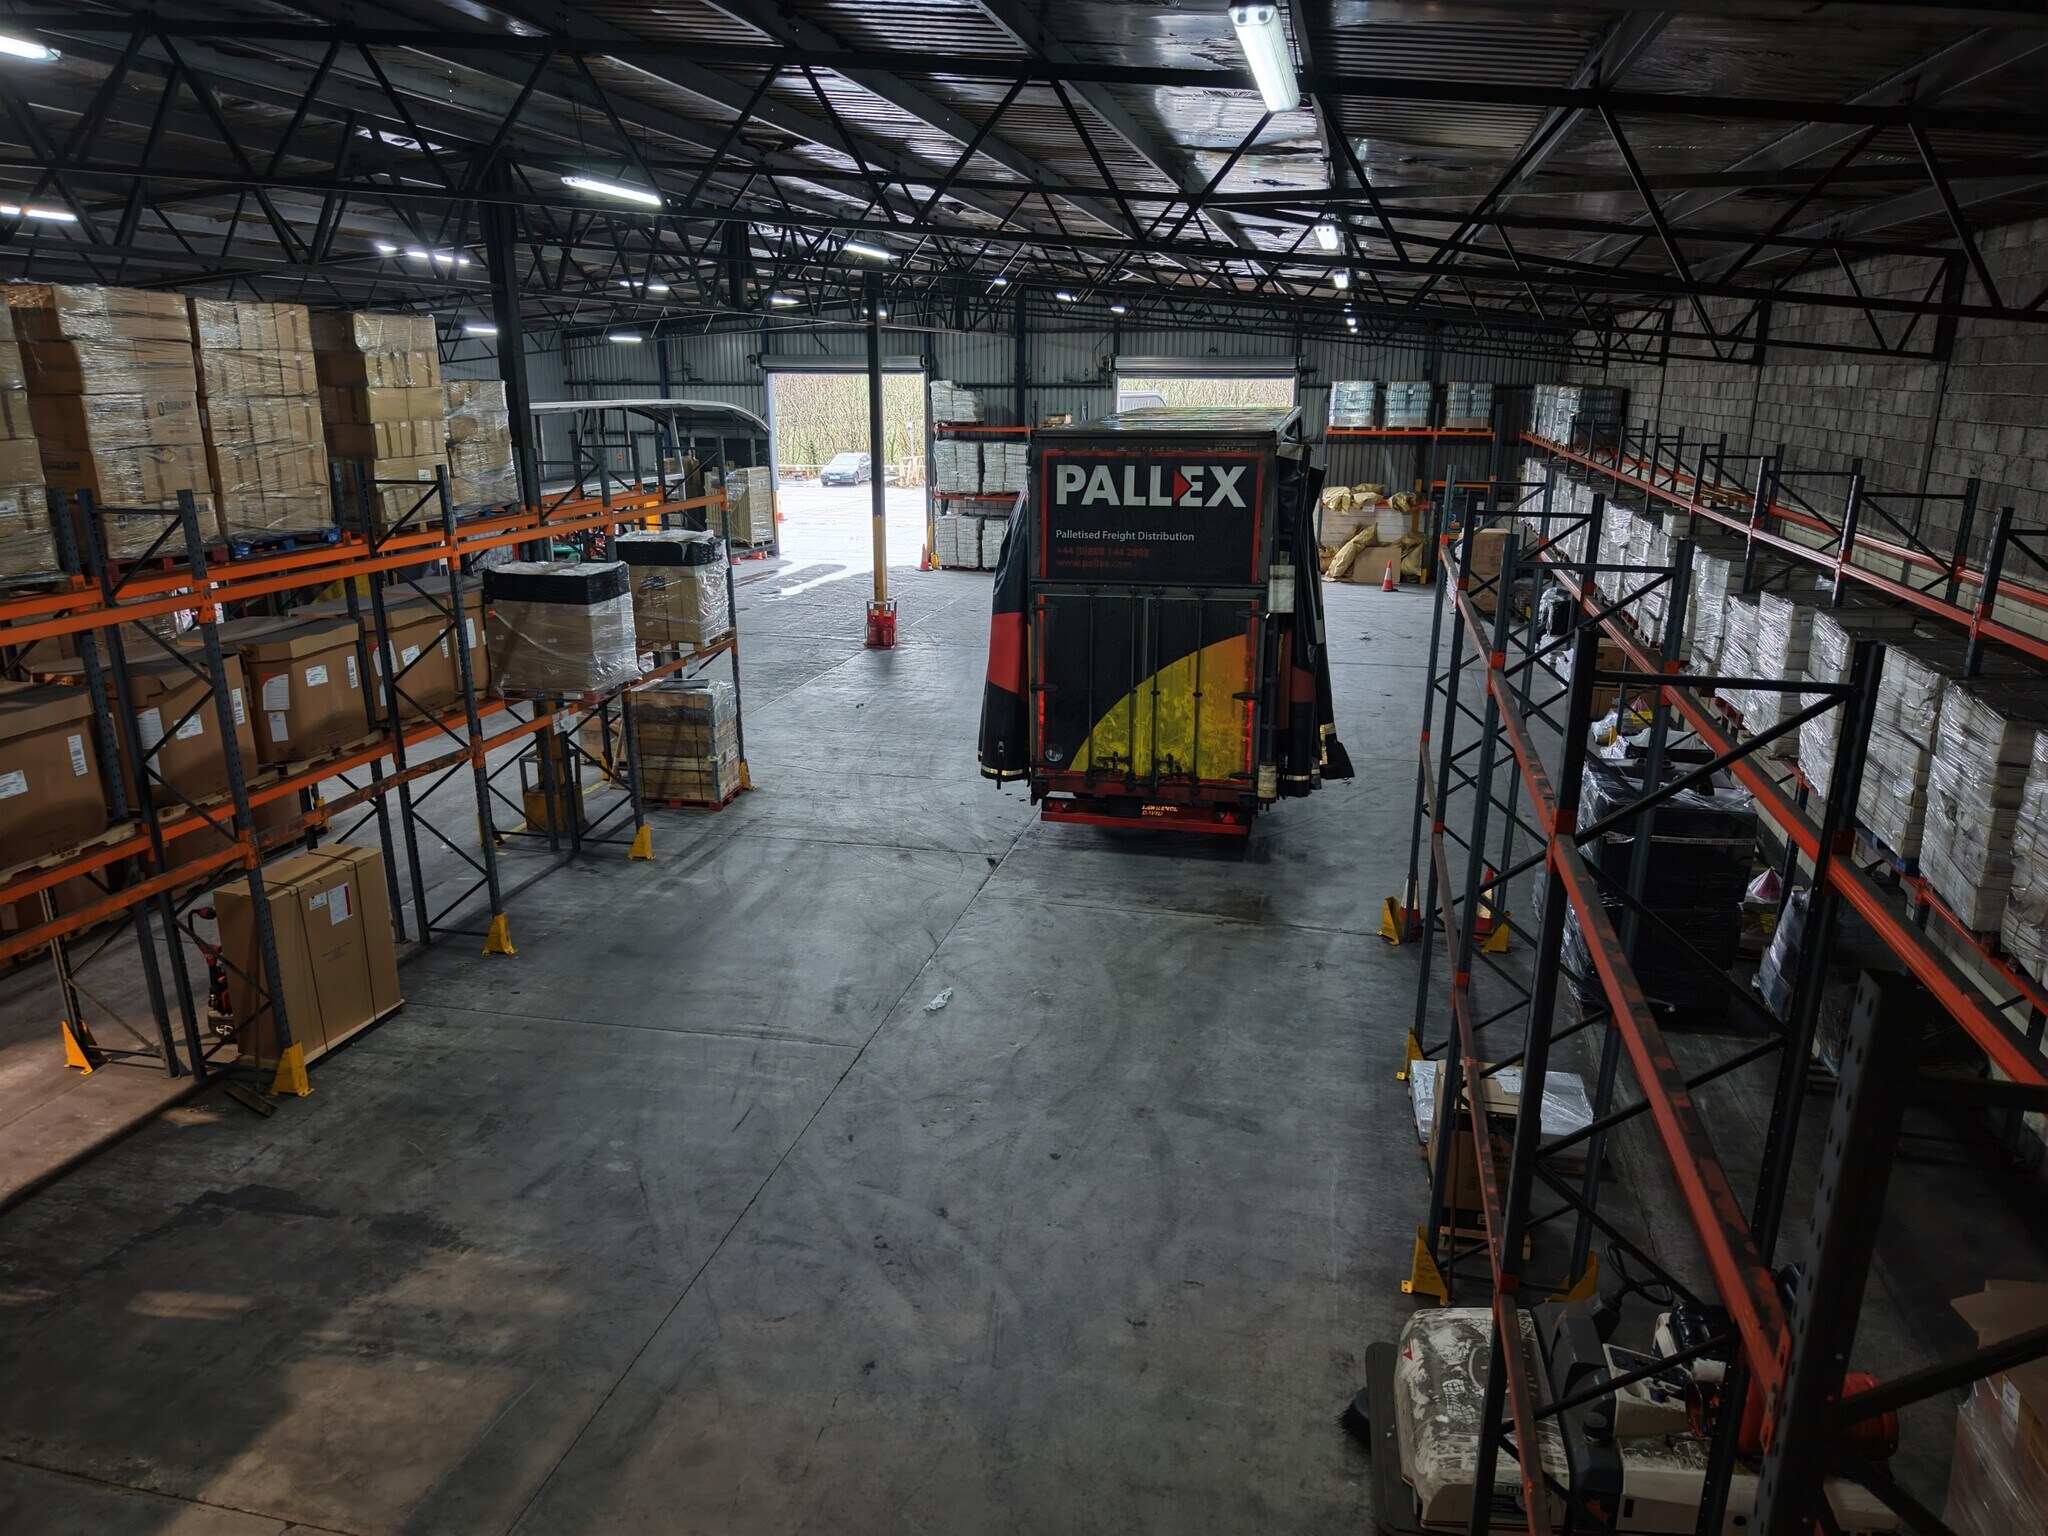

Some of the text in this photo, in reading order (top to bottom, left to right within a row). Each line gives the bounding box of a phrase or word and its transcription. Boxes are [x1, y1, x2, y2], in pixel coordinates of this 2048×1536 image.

[1056, 464, 1247, 508] PALLEX
[1056, 529, 1195, 542] Palletised Freight Distribution
[1057, 546, 1074, 555] +44
[1056, 559, 1132, 569] www.pallex.com
